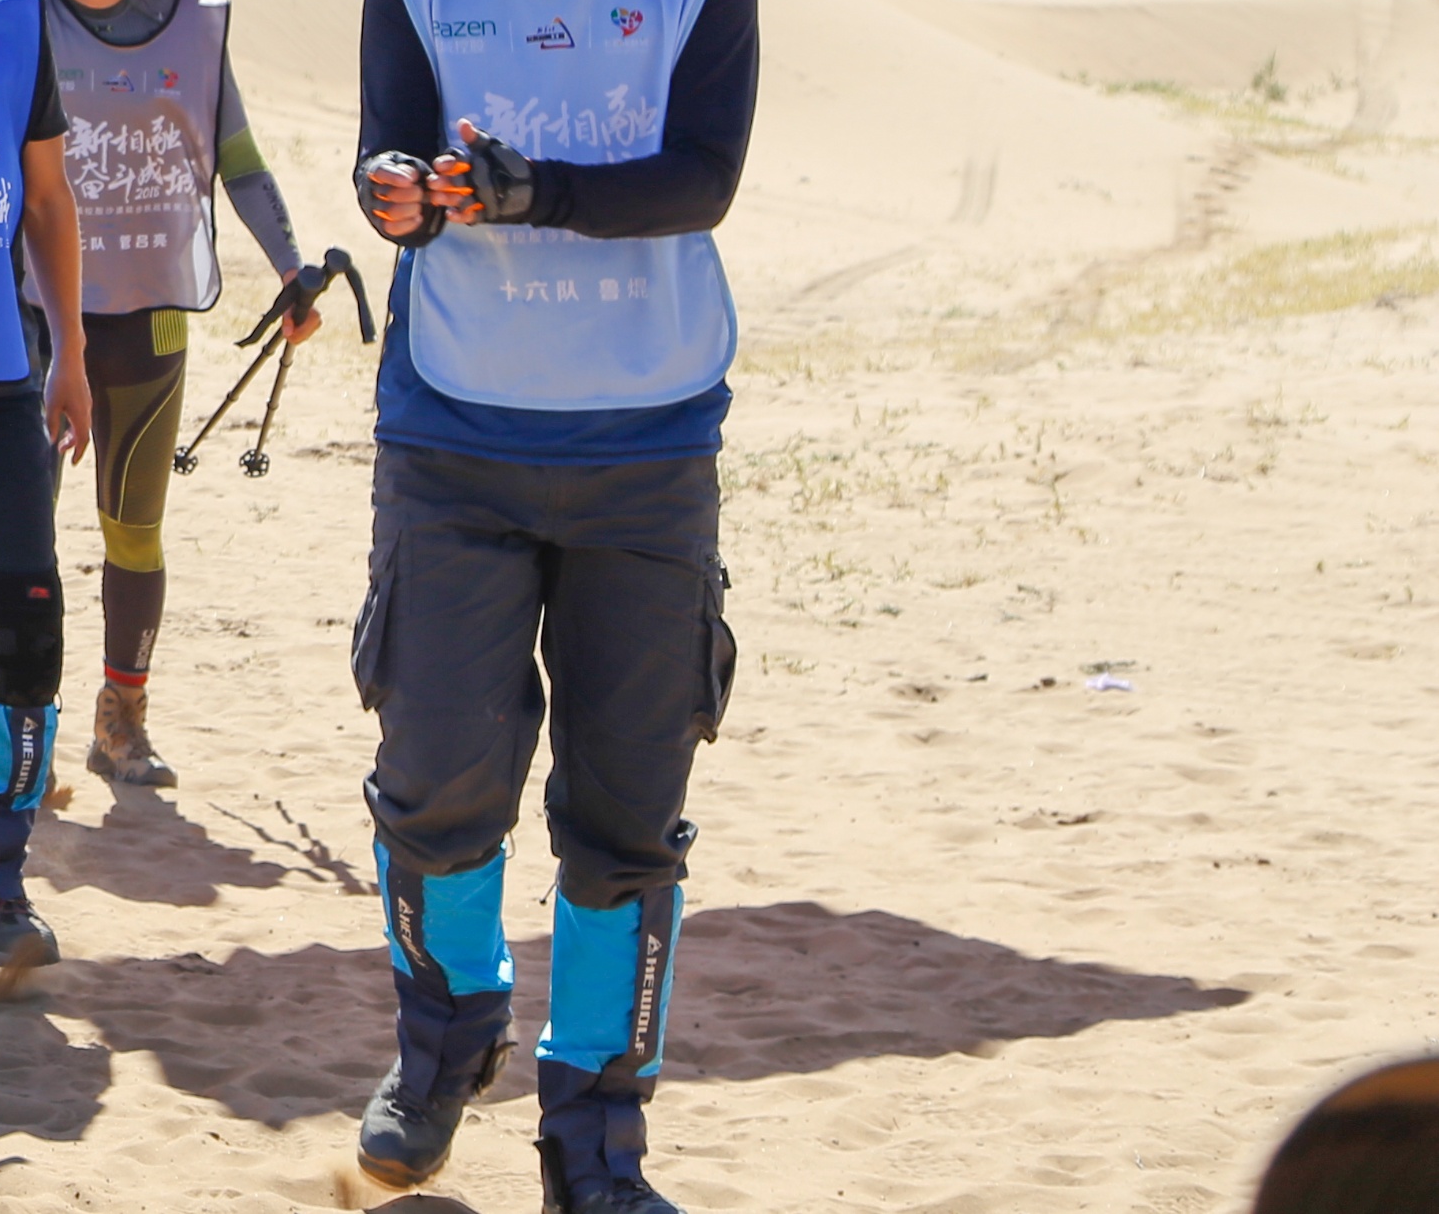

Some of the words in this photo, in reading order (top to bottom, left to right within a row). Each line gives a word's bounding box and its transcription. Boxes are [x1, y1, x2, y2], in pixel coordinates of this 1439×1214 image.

[433, 19, 497, 37] eazen
[64, 115, 183, 174] 新相融
[500, 279, 580, 302] 十六队
